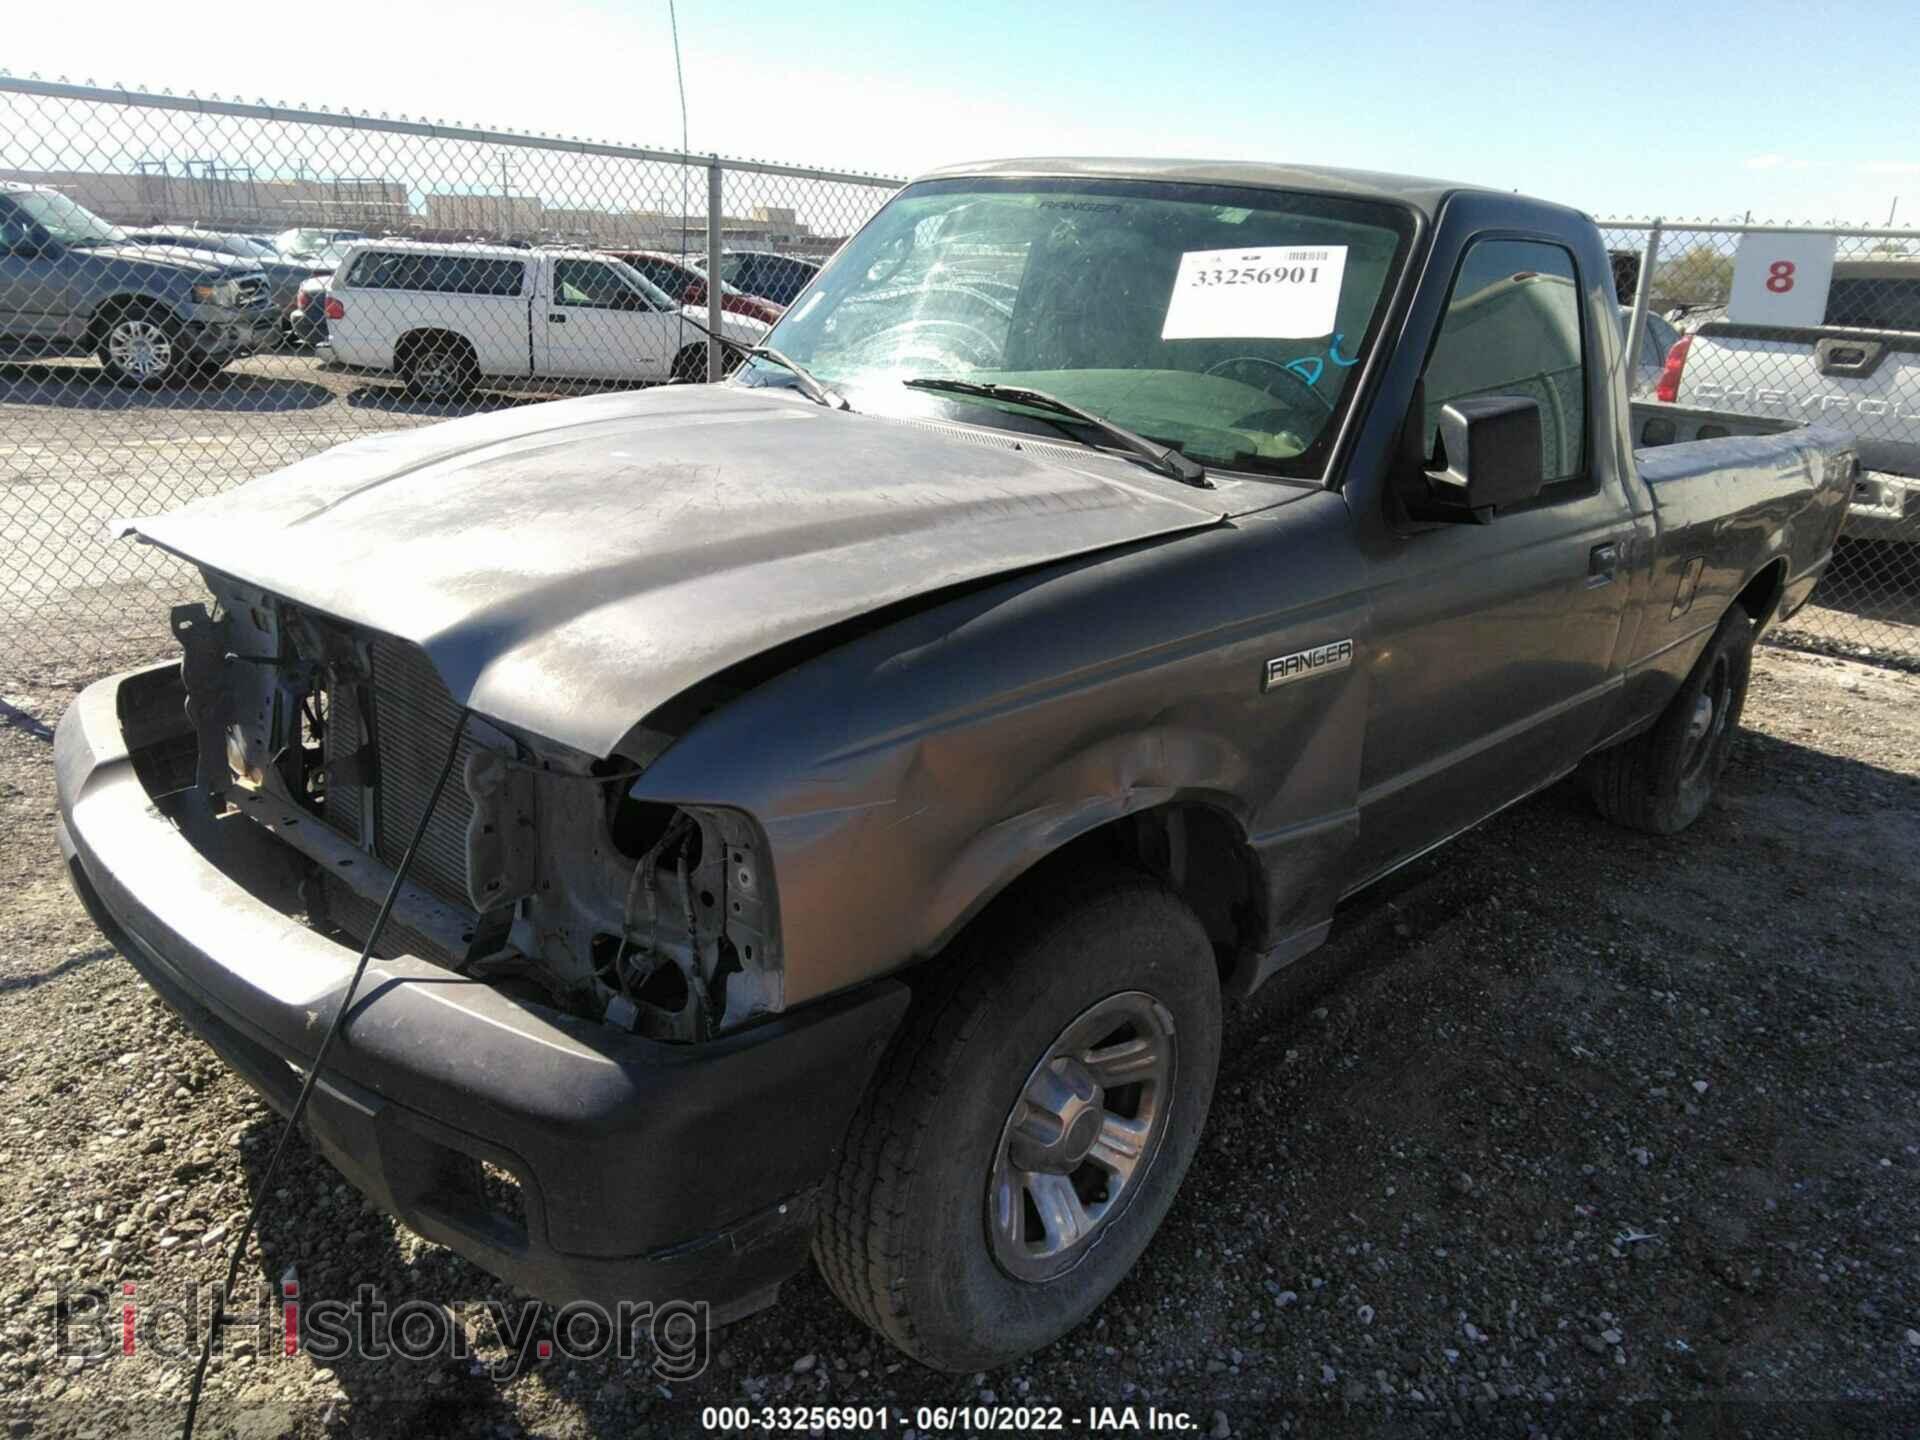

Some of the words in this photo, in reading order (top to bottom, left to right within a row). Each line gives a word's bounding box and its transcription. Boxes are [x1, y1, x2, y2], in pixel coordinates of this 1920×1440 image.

[1191, 266, 1320, 287] 33256901
[1766, 261, 1796, 293] 8
[1269, 641, 1352, 681] RANGER
